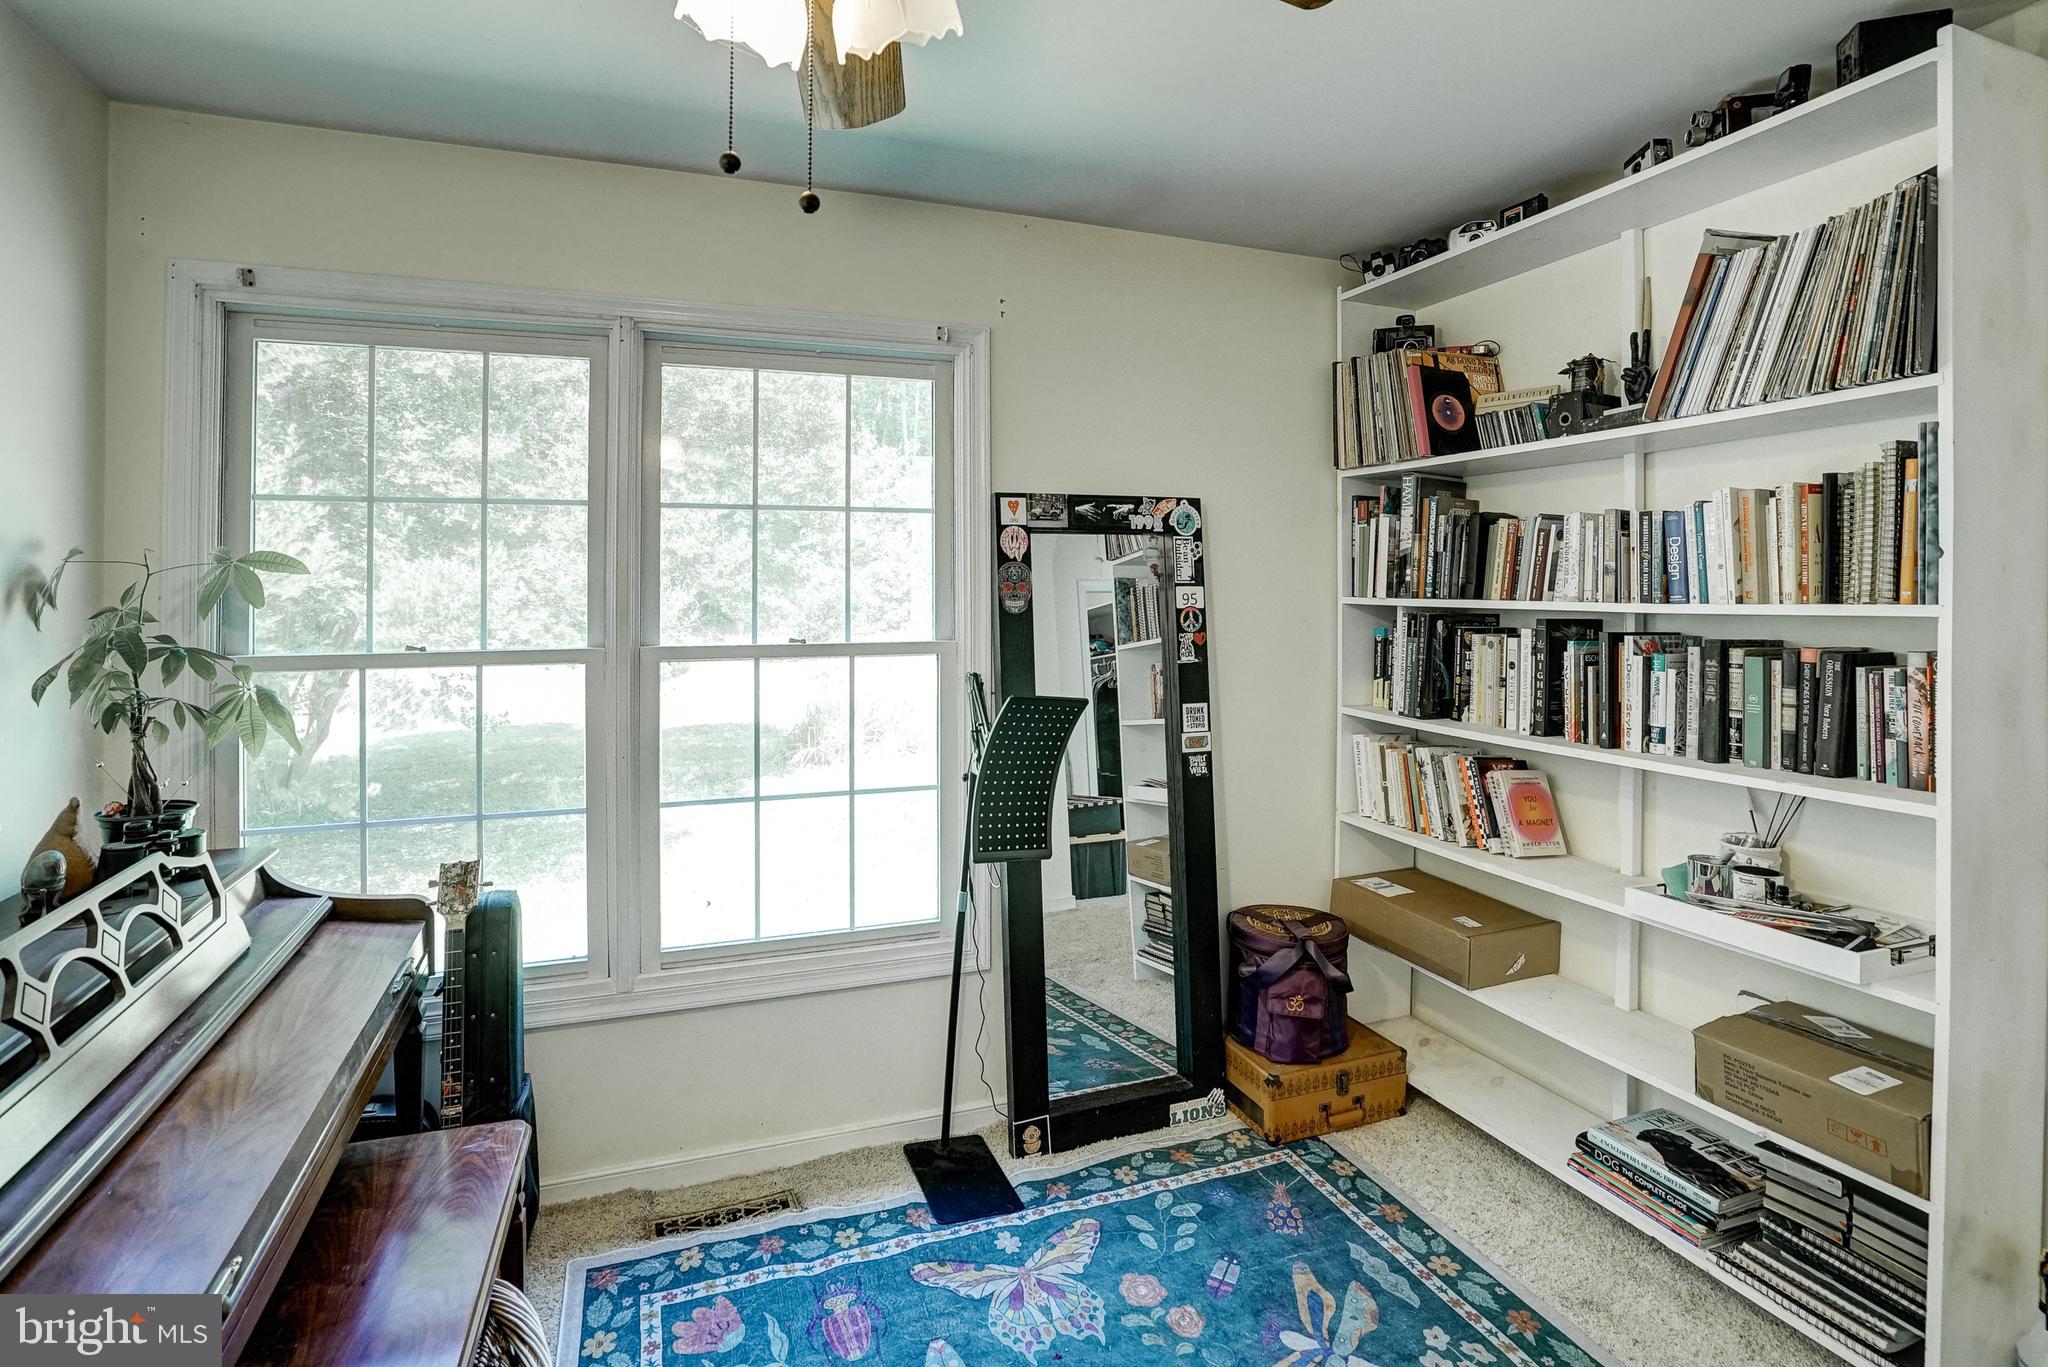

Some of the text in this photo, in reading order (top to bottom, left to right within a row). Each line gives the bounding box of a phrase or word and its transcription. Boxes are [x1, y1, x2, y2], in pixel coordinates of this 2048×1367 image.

[1175, 539, 1184, 580] Outsider
[1668, 536, 1682, 581] Design
[1182, 593, 1198, 605] 95
[1537, 652, 1545, 708] HIGHER
[1821, 660, 1834, 740] OBSESSION Nora Roberts
[1186, 706, 1205, 715] DRUNK
[1186, 715, 1206, 723] STONED
[1857, 697, 1865, 747] THE CLEARING
[1912, 700, 1926, 757] THE COMEBACK
[1473, 777, 1483, 804] POEHLER
[1526, 818, 1554, 826] MAGNET
[1171, 1102, 1226, 1126] LIONS
[1645, 1113, 1685, 1129] DOG
[1594, 1149, 1620, 1172] DOG
[1621, 1166, 1634, 1179] THE
[1634, 1174, 1667, 1199] COMPLETE
[1666, 1193, 1688, 1212] GUIDE
[1600, 1138, 1641, 1165] ENCYCLOPEDIA
[1649, 1166, 1663, 1179] DOG
[1663, 1174, 1688, 1193] BREEDS
